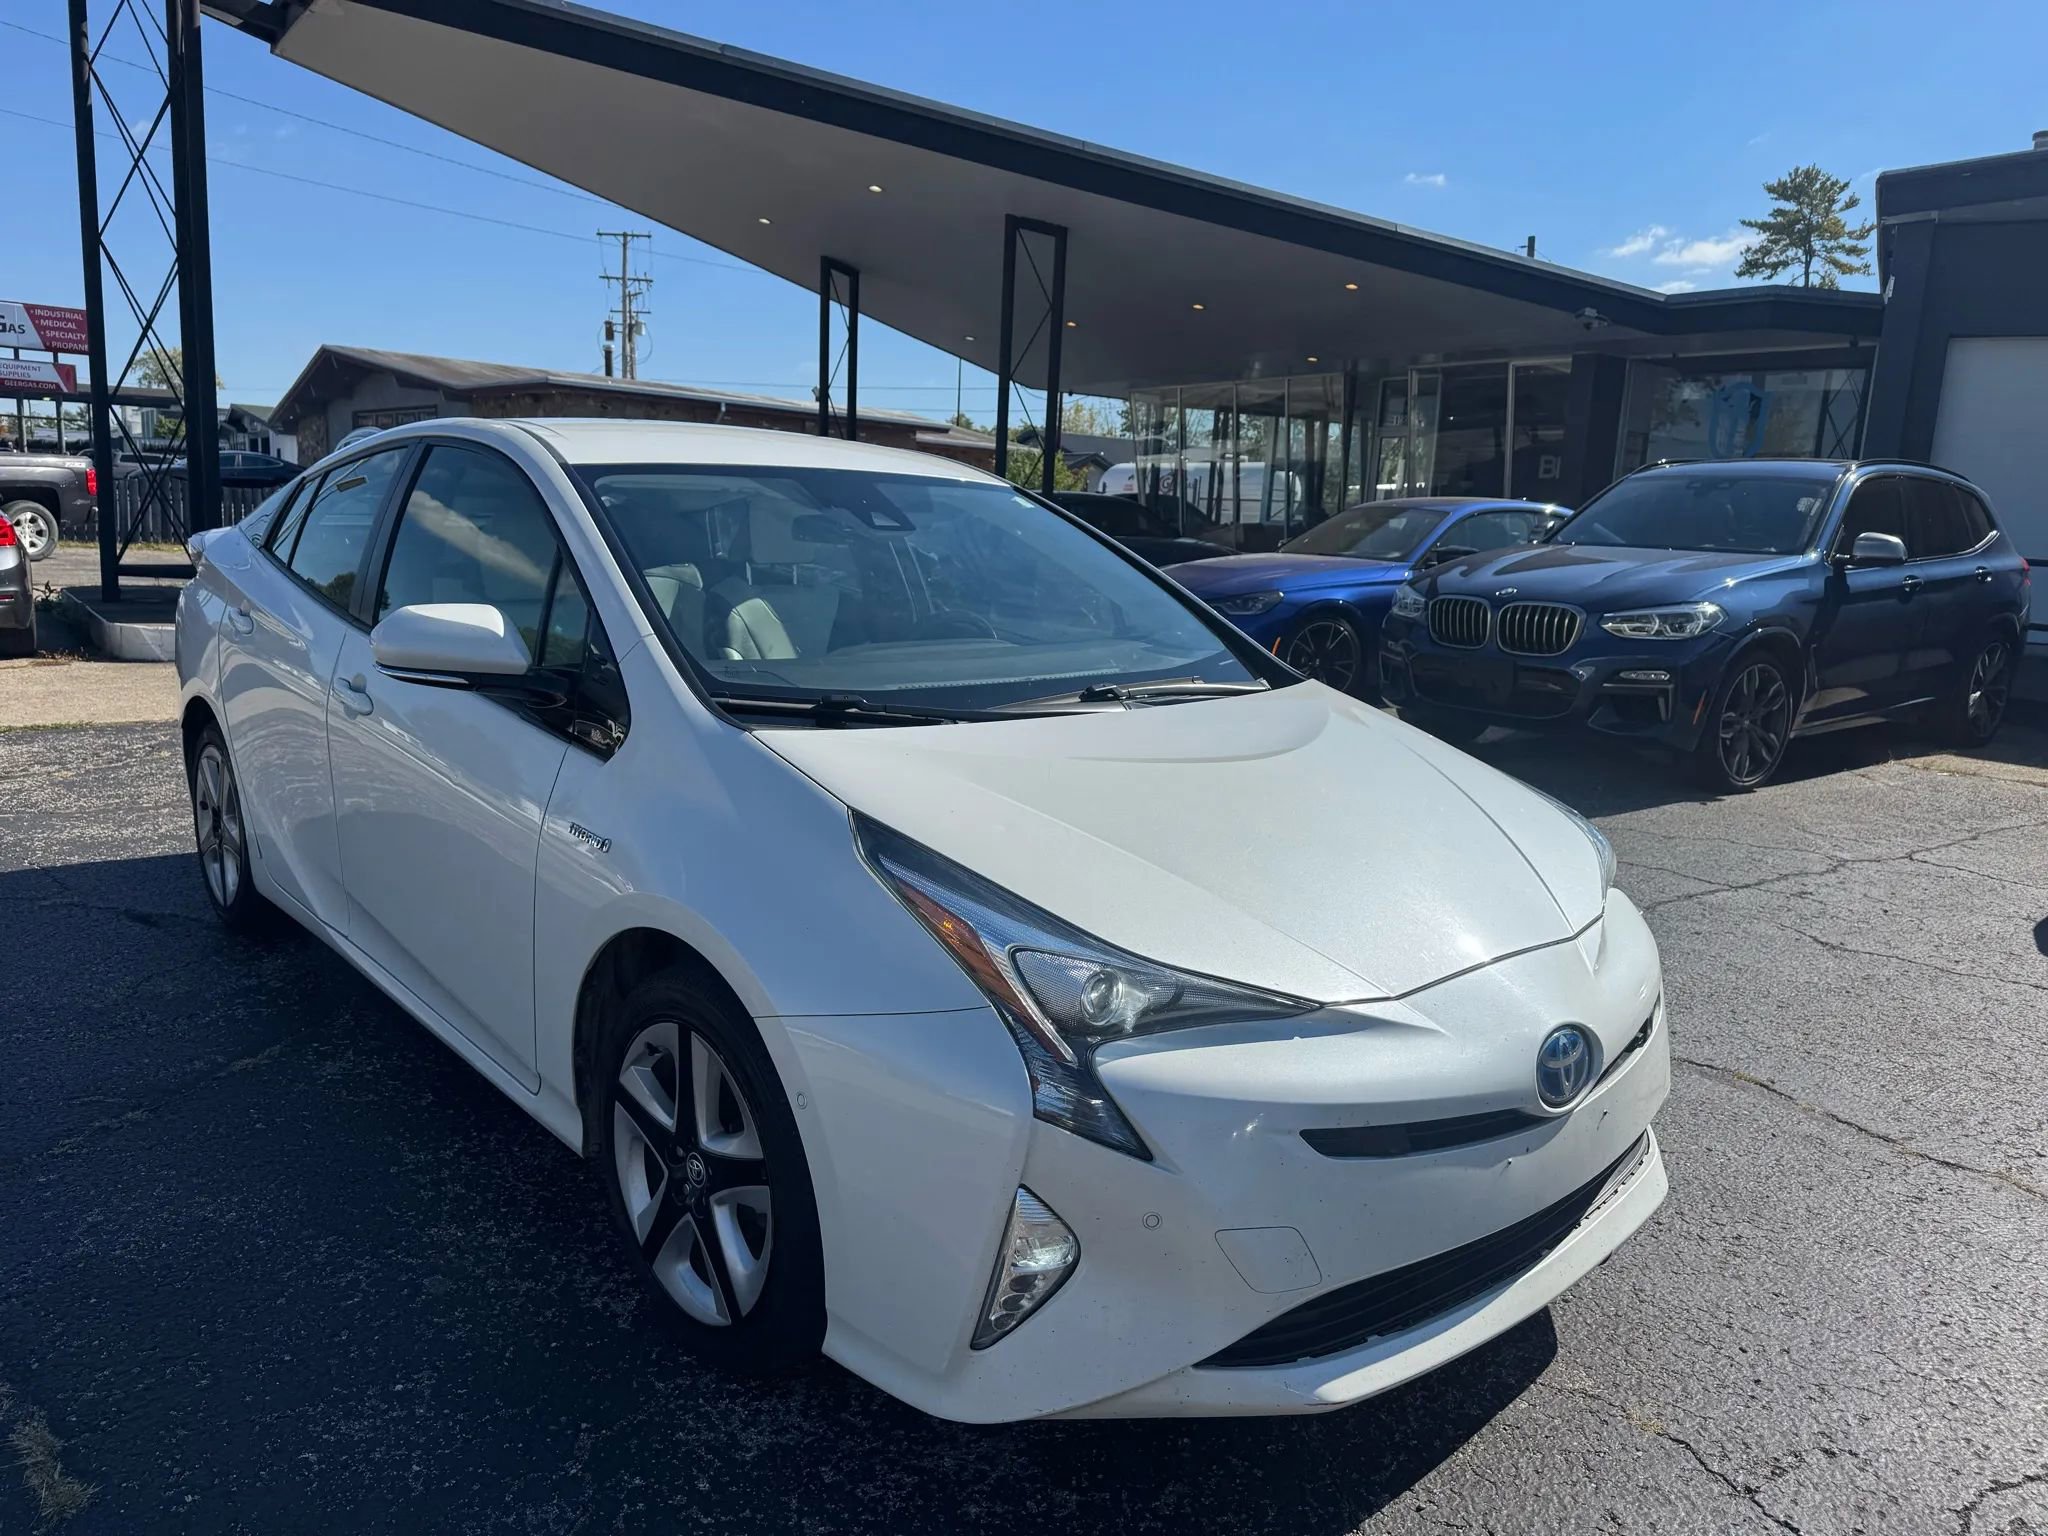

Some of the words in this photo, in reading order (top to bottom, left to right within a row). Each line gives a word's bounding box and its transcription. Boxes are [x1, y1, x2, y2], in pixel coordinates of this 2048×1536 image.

[35, 308, 82, 321] INDUSTRIAL
[40, 319, 77, 330] MEDICAL
[45, 330, 86, 341] SPECIALTY
